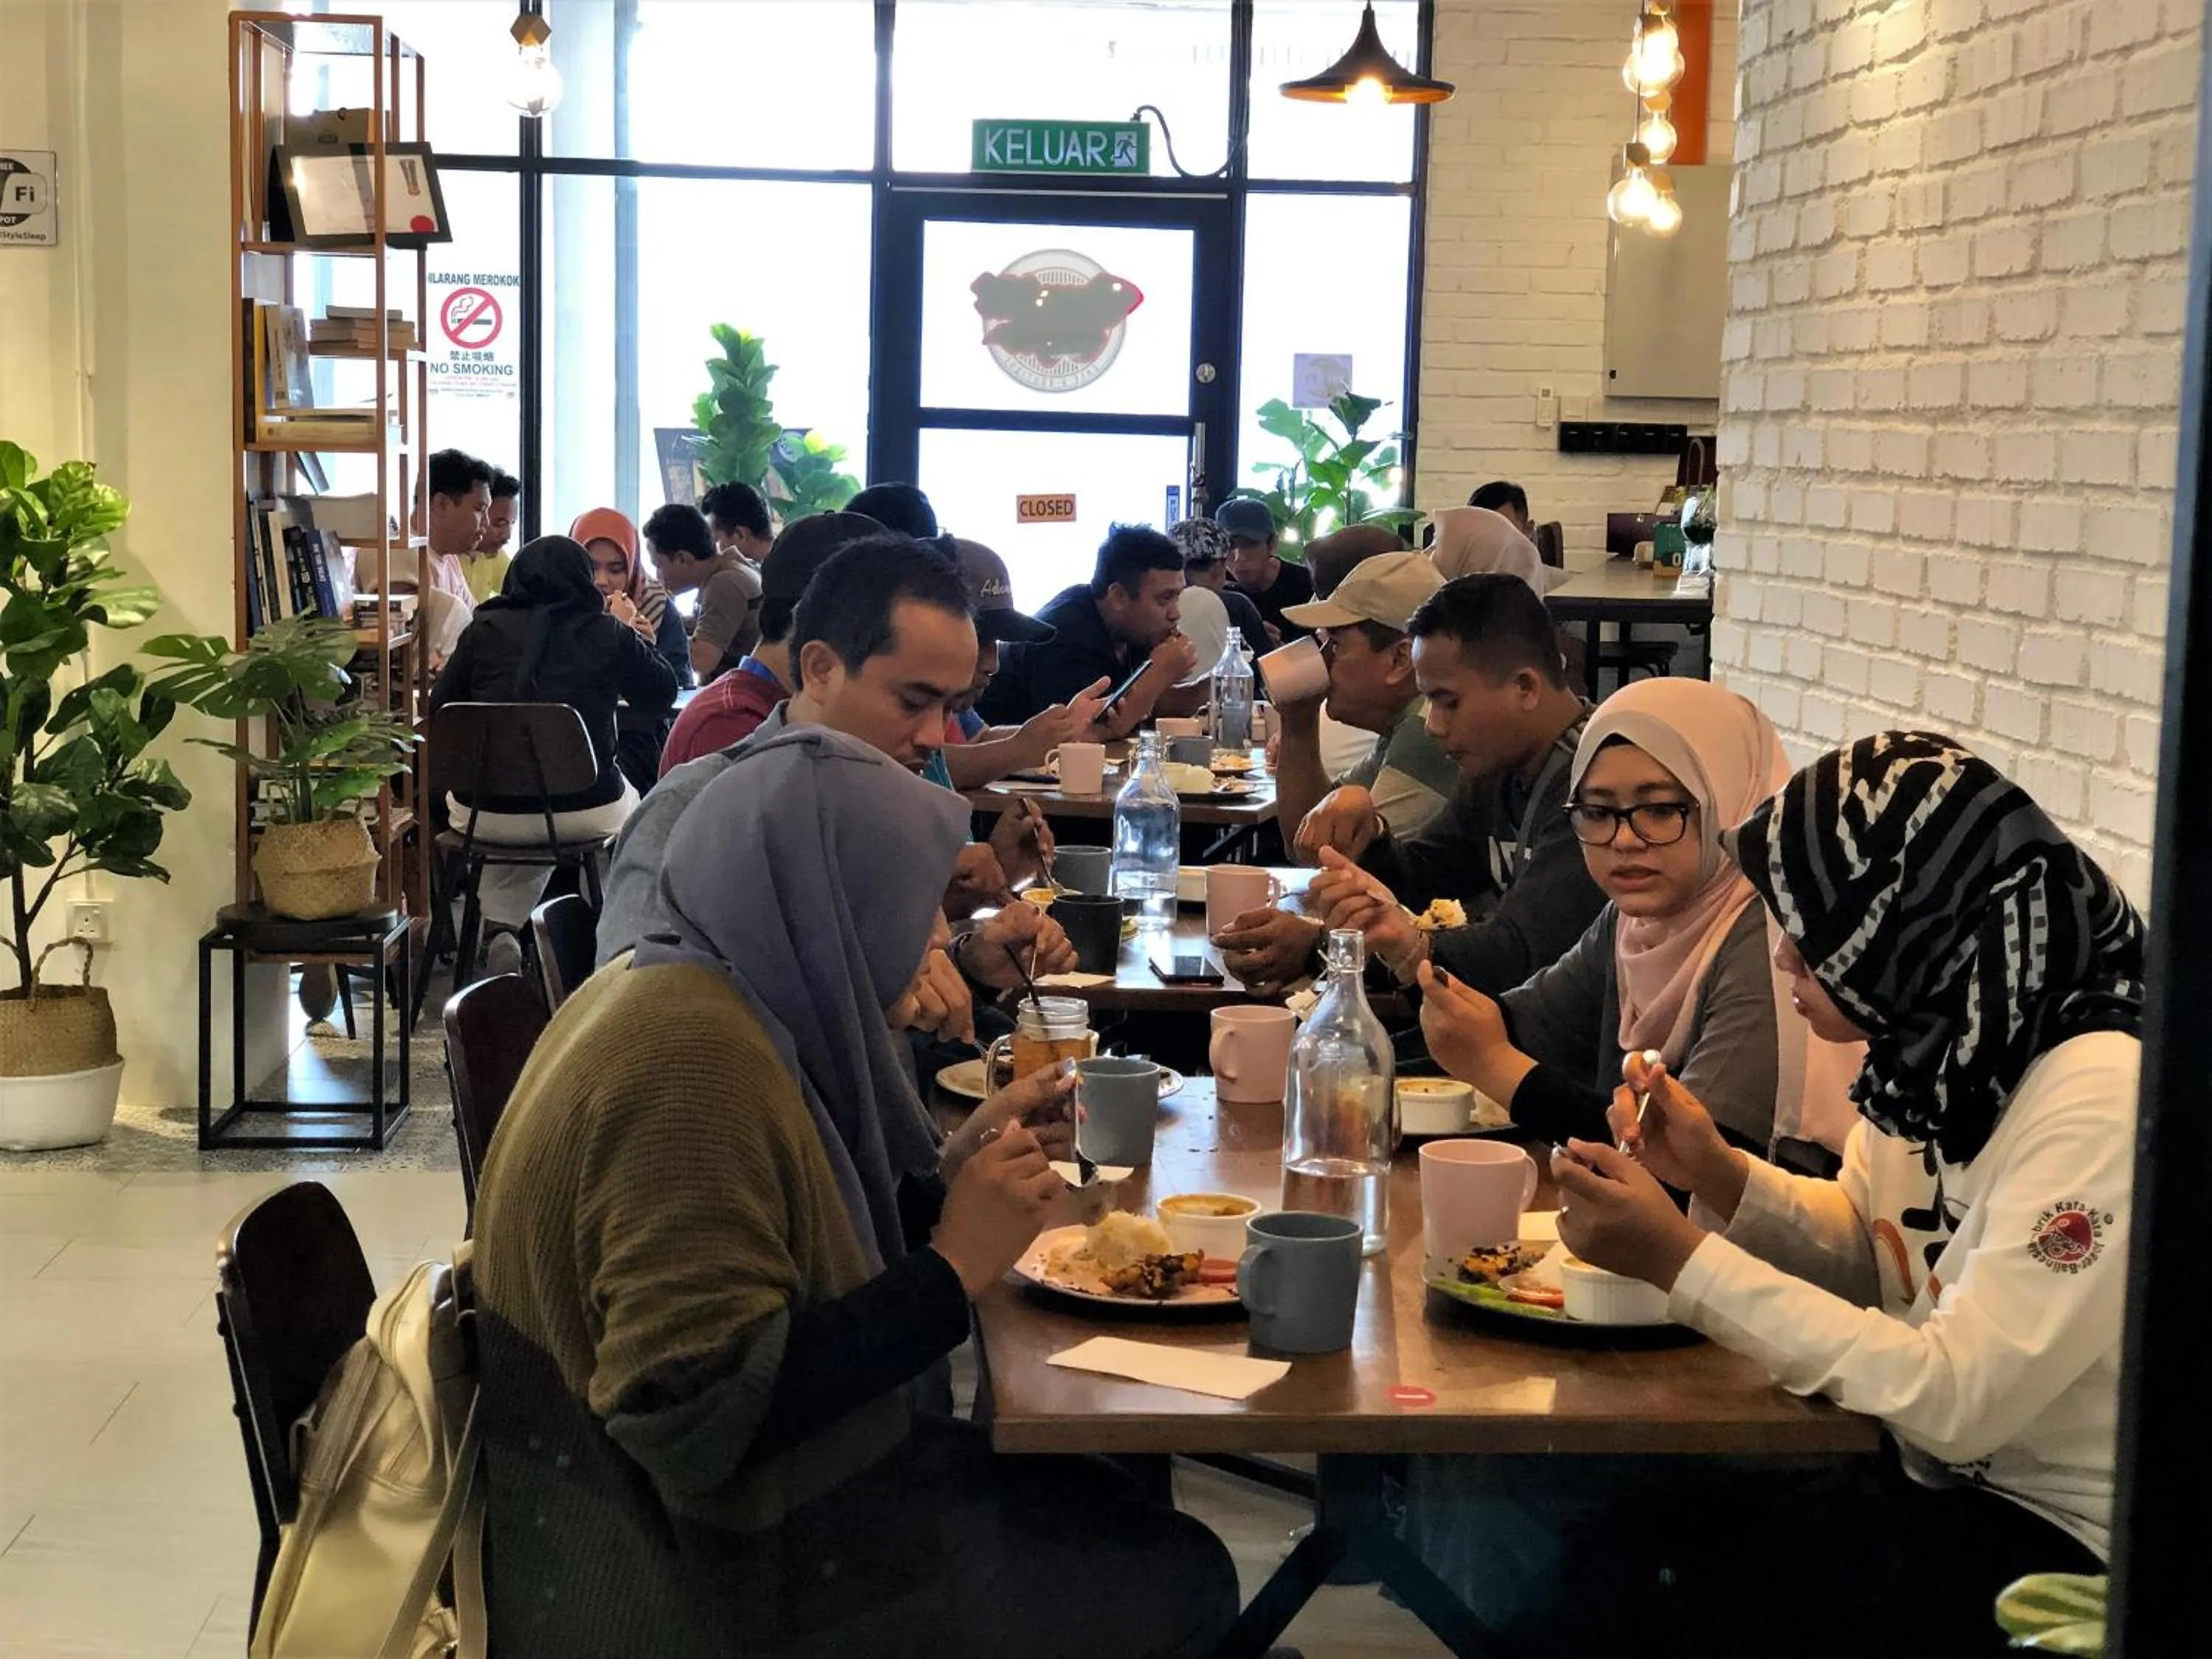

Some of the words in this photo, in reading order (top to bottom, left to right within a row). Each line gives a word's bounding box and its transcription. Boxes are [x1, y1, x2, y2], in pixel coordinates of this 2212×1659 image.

[984, 128, 1107, 167] KELUAR
[15, 186, 35, 202] Fi
[473, 274, 520, 287] MEROKOK
[430, 362, 449, 374] NO
[453, 363, 514, 376] SMOKING
[1020, 499, 1074, 517] CLOSED
